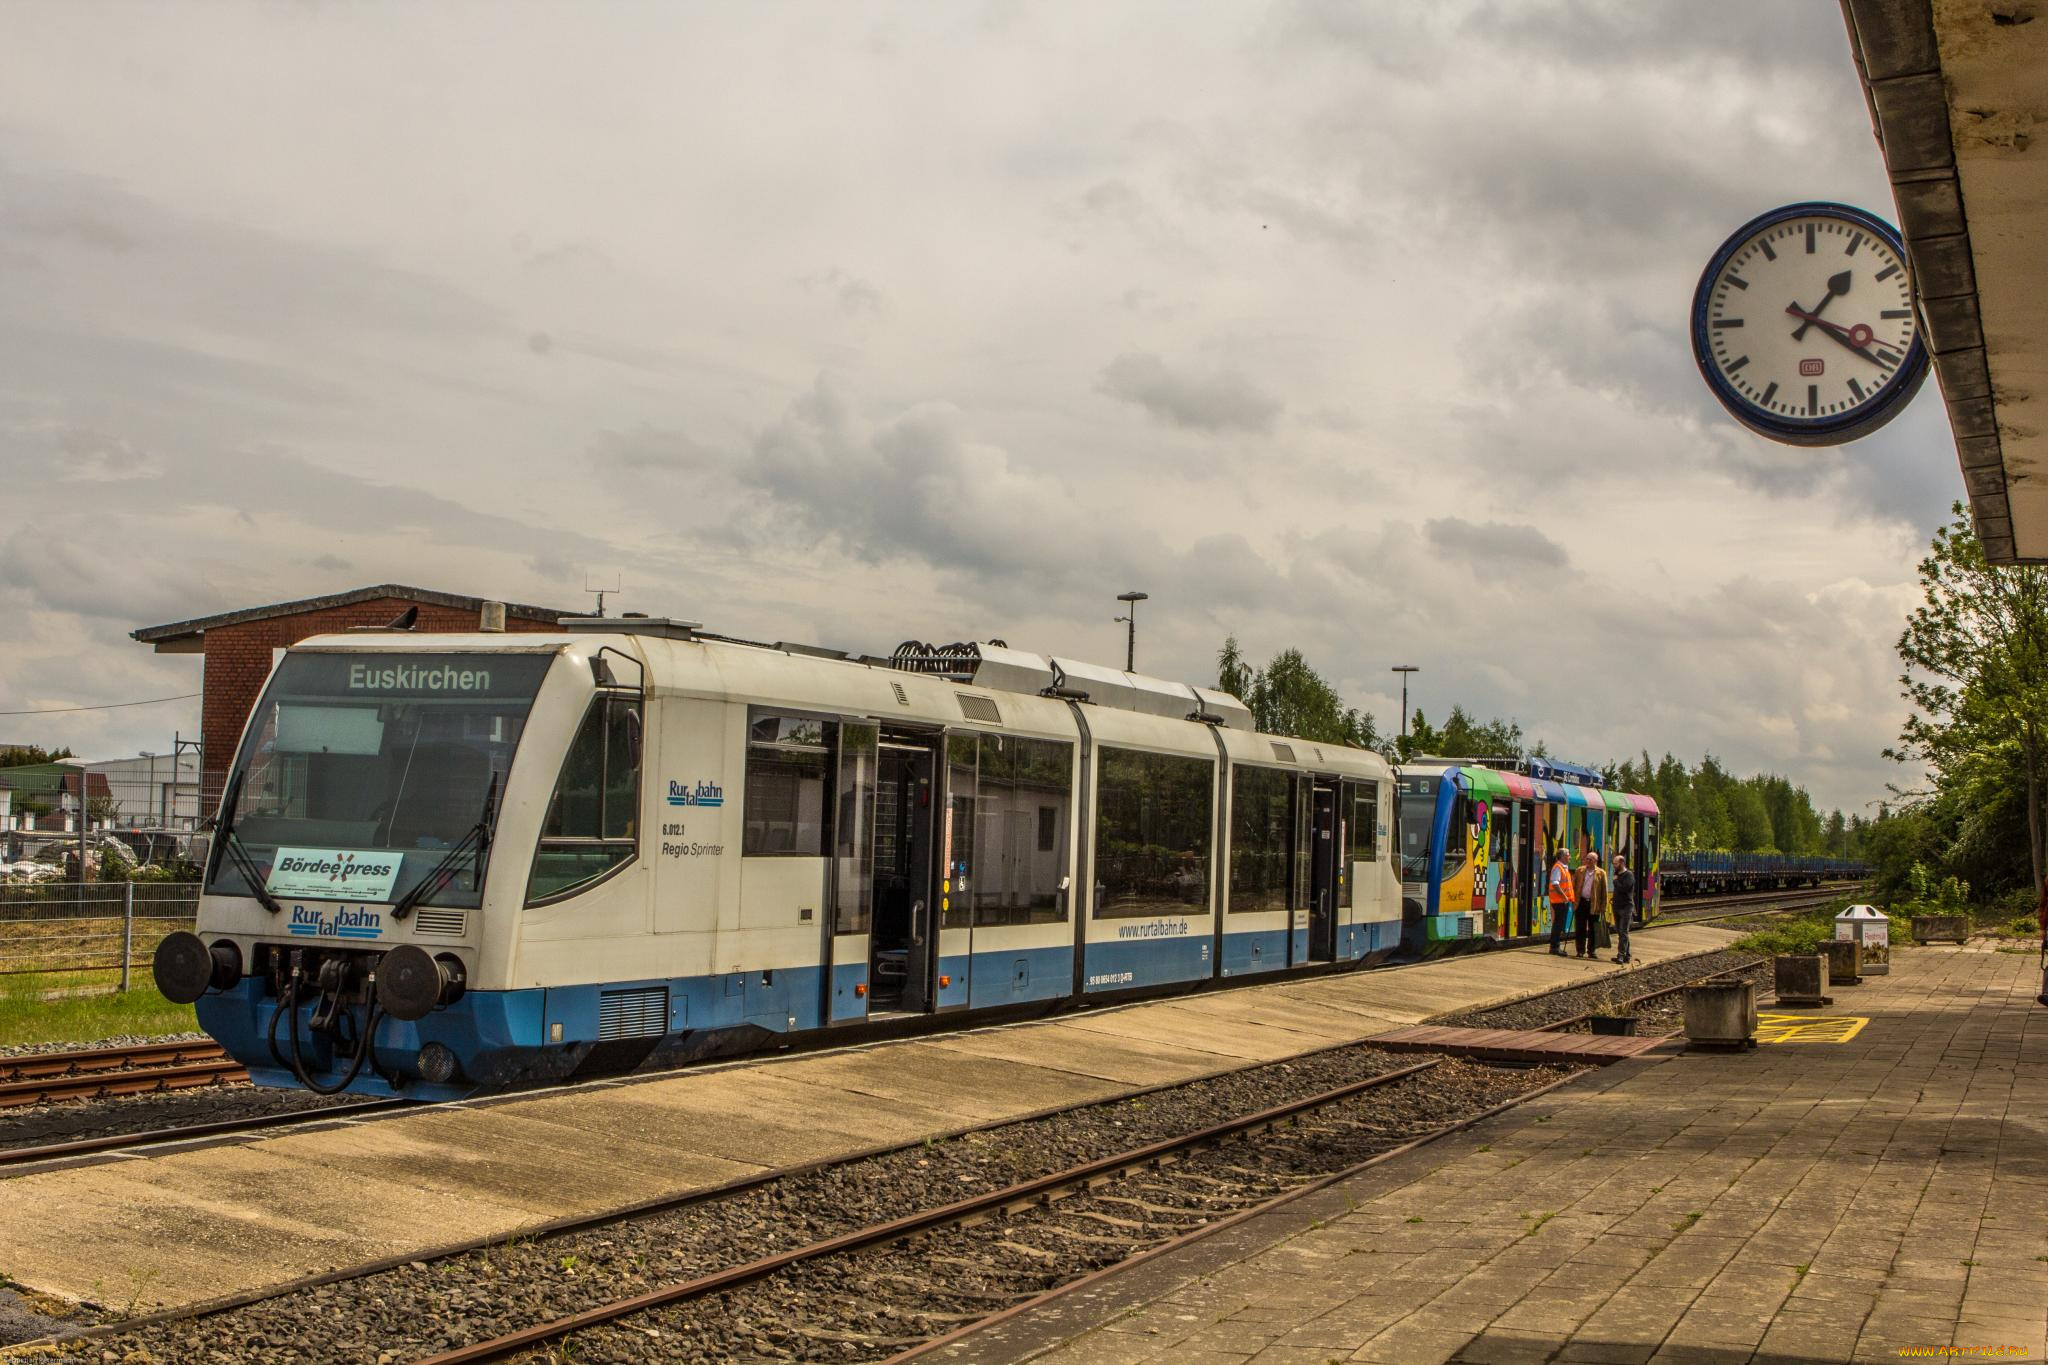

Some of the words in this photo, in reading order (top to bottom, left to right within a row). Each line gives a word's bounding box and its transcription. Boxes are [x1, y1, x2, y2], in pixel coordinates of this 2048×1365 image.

[350, 664, 490, 690] Euskirchen
[669, 780, 723, 806] Rurtalbahn
[662, 823, 685, 836] 6.012.1
[291, 905, 381, 936] Rurtalbahn
[1119, 918, 1188, 938] www.rurtalbahn.de
